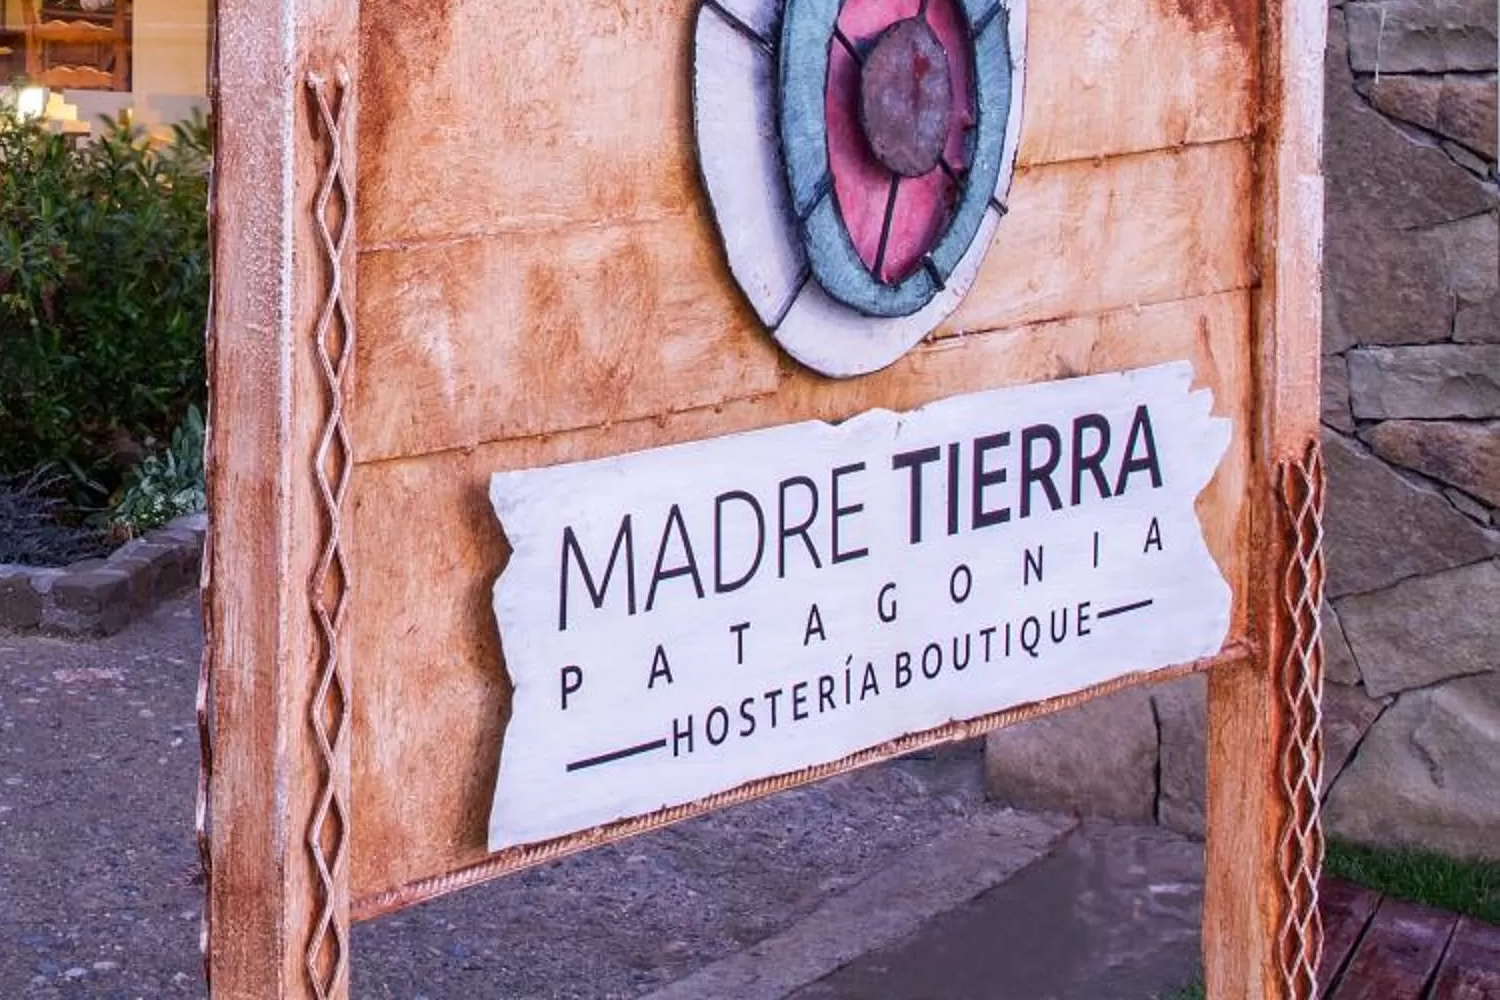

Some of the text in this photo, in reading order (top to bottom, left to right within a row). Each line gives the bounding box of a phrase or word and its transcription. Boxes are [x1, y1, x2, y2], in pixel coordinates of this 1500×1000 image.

[558, 404, 1163, 632] MADRE TIERRA
[561, 516, 1163, 711] PATAGONIA
[672, 601, 1091, 758] HOSTERÍA BOUTIQUE
